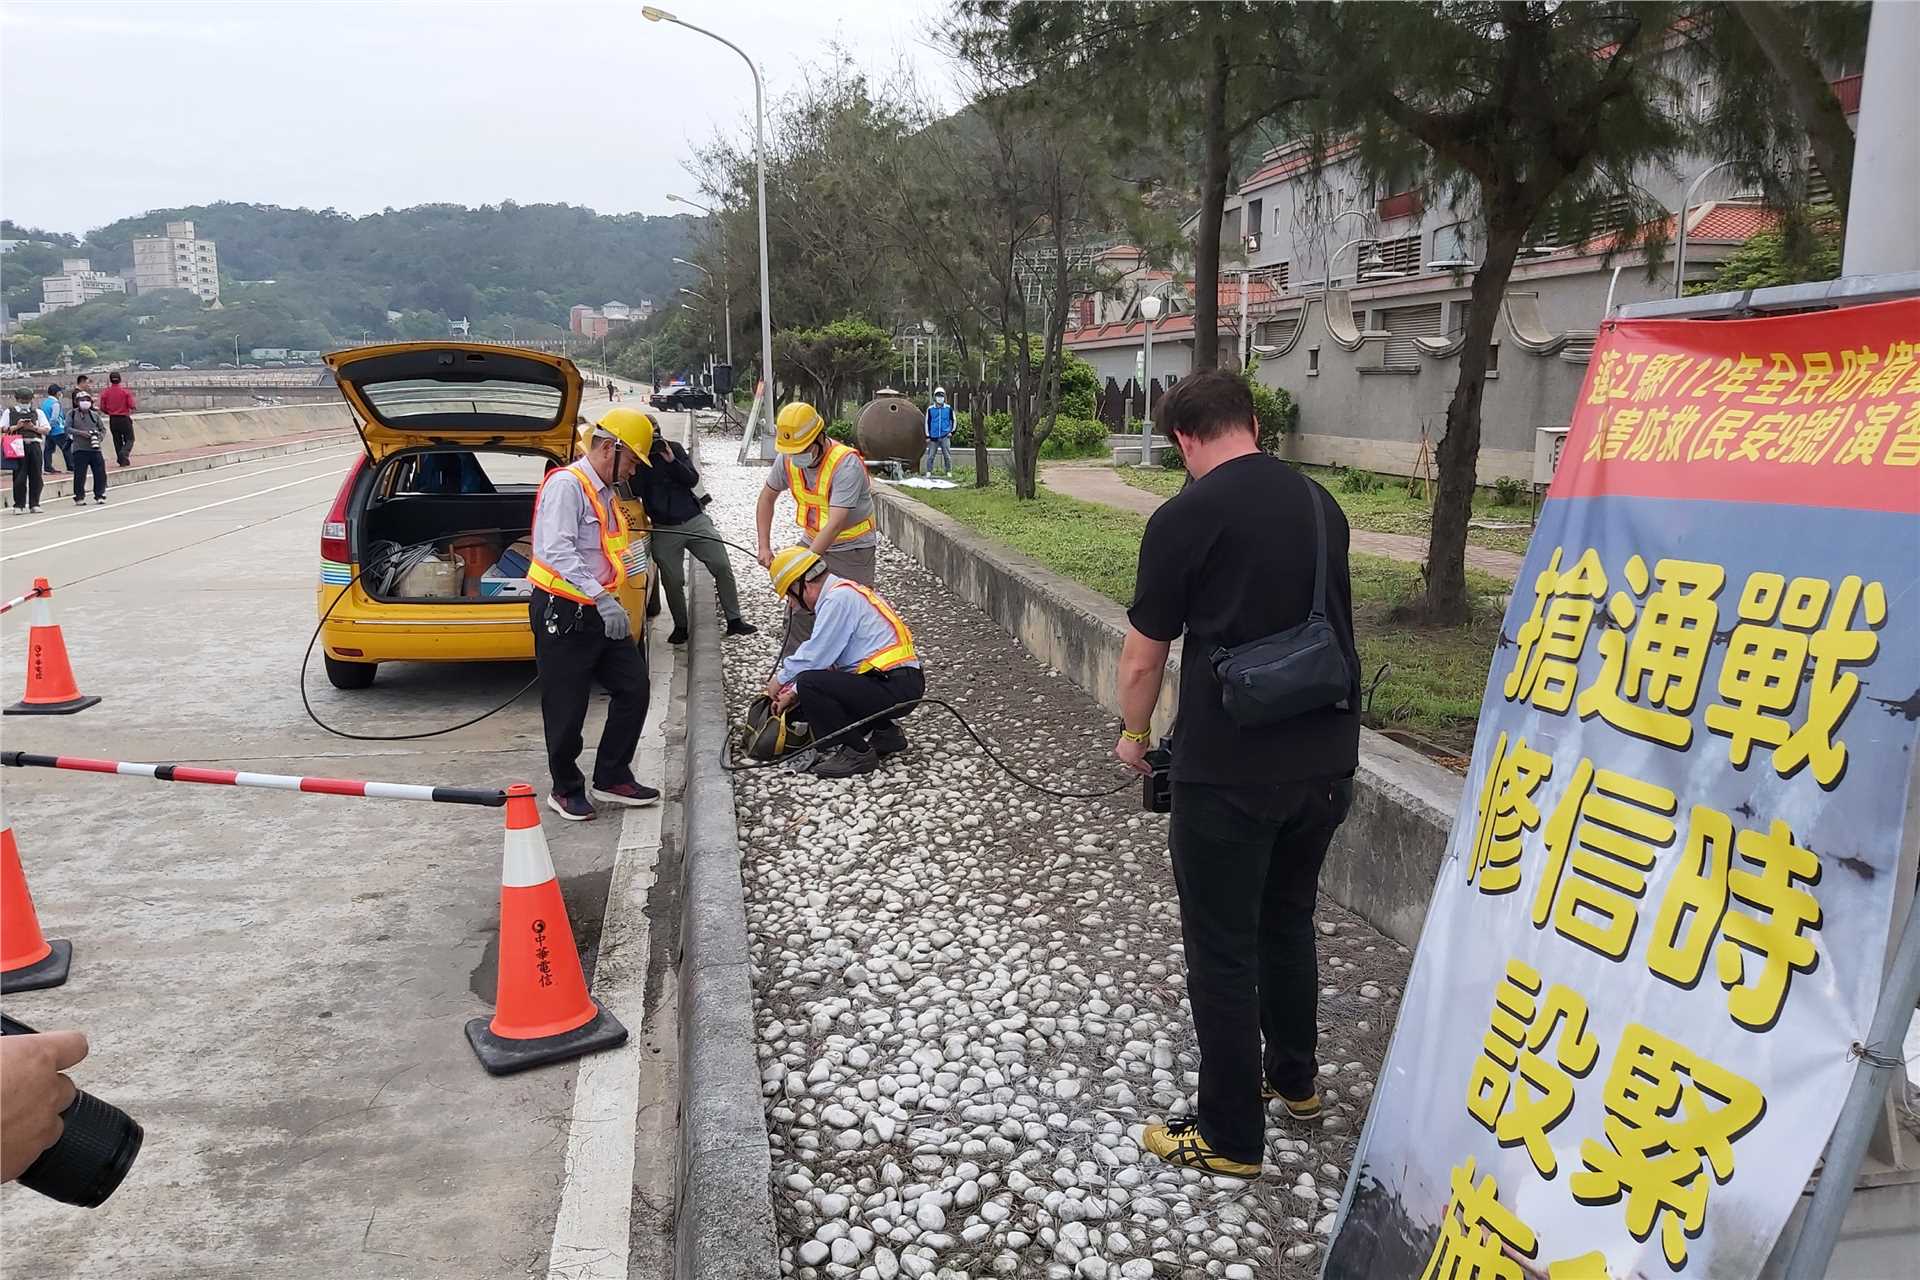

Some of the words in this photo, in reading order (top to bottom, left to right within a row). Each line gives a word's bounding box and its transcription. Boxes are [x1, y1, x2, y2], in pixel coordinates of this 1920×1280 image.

[1467, 546, 1610, 896] 搶修
[535, 933, 552, 988] 中華電信
